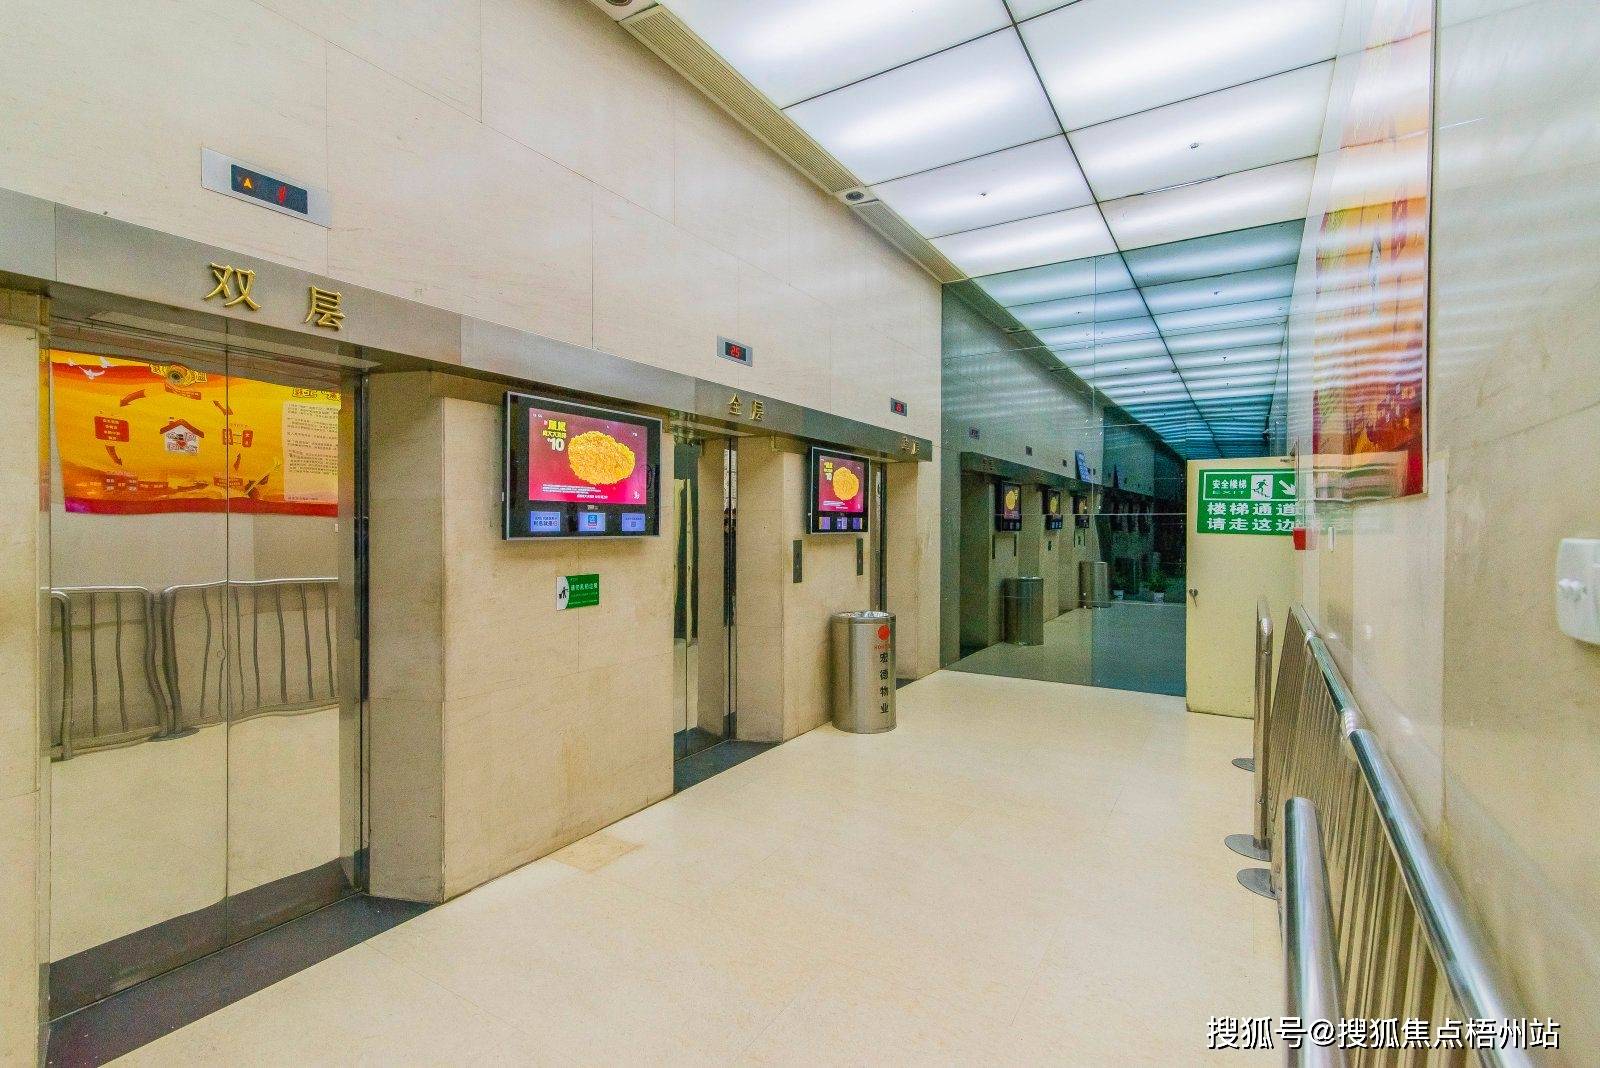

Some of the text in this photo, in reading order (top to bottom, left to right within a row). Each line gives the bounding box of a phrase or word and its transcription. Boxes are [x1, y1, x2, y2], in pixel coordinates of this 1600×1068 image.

[202, 261, 346, 331] 双层
[728, 393, 765, 422] 全层
[1212, 479, 1247, 490] 安全楼梯
[1206, 502, 1296, 516] 楼梯通道
[1206, 517, 1296, 531] 请走这边
[879, 651, 889, 714] 宏德物业
